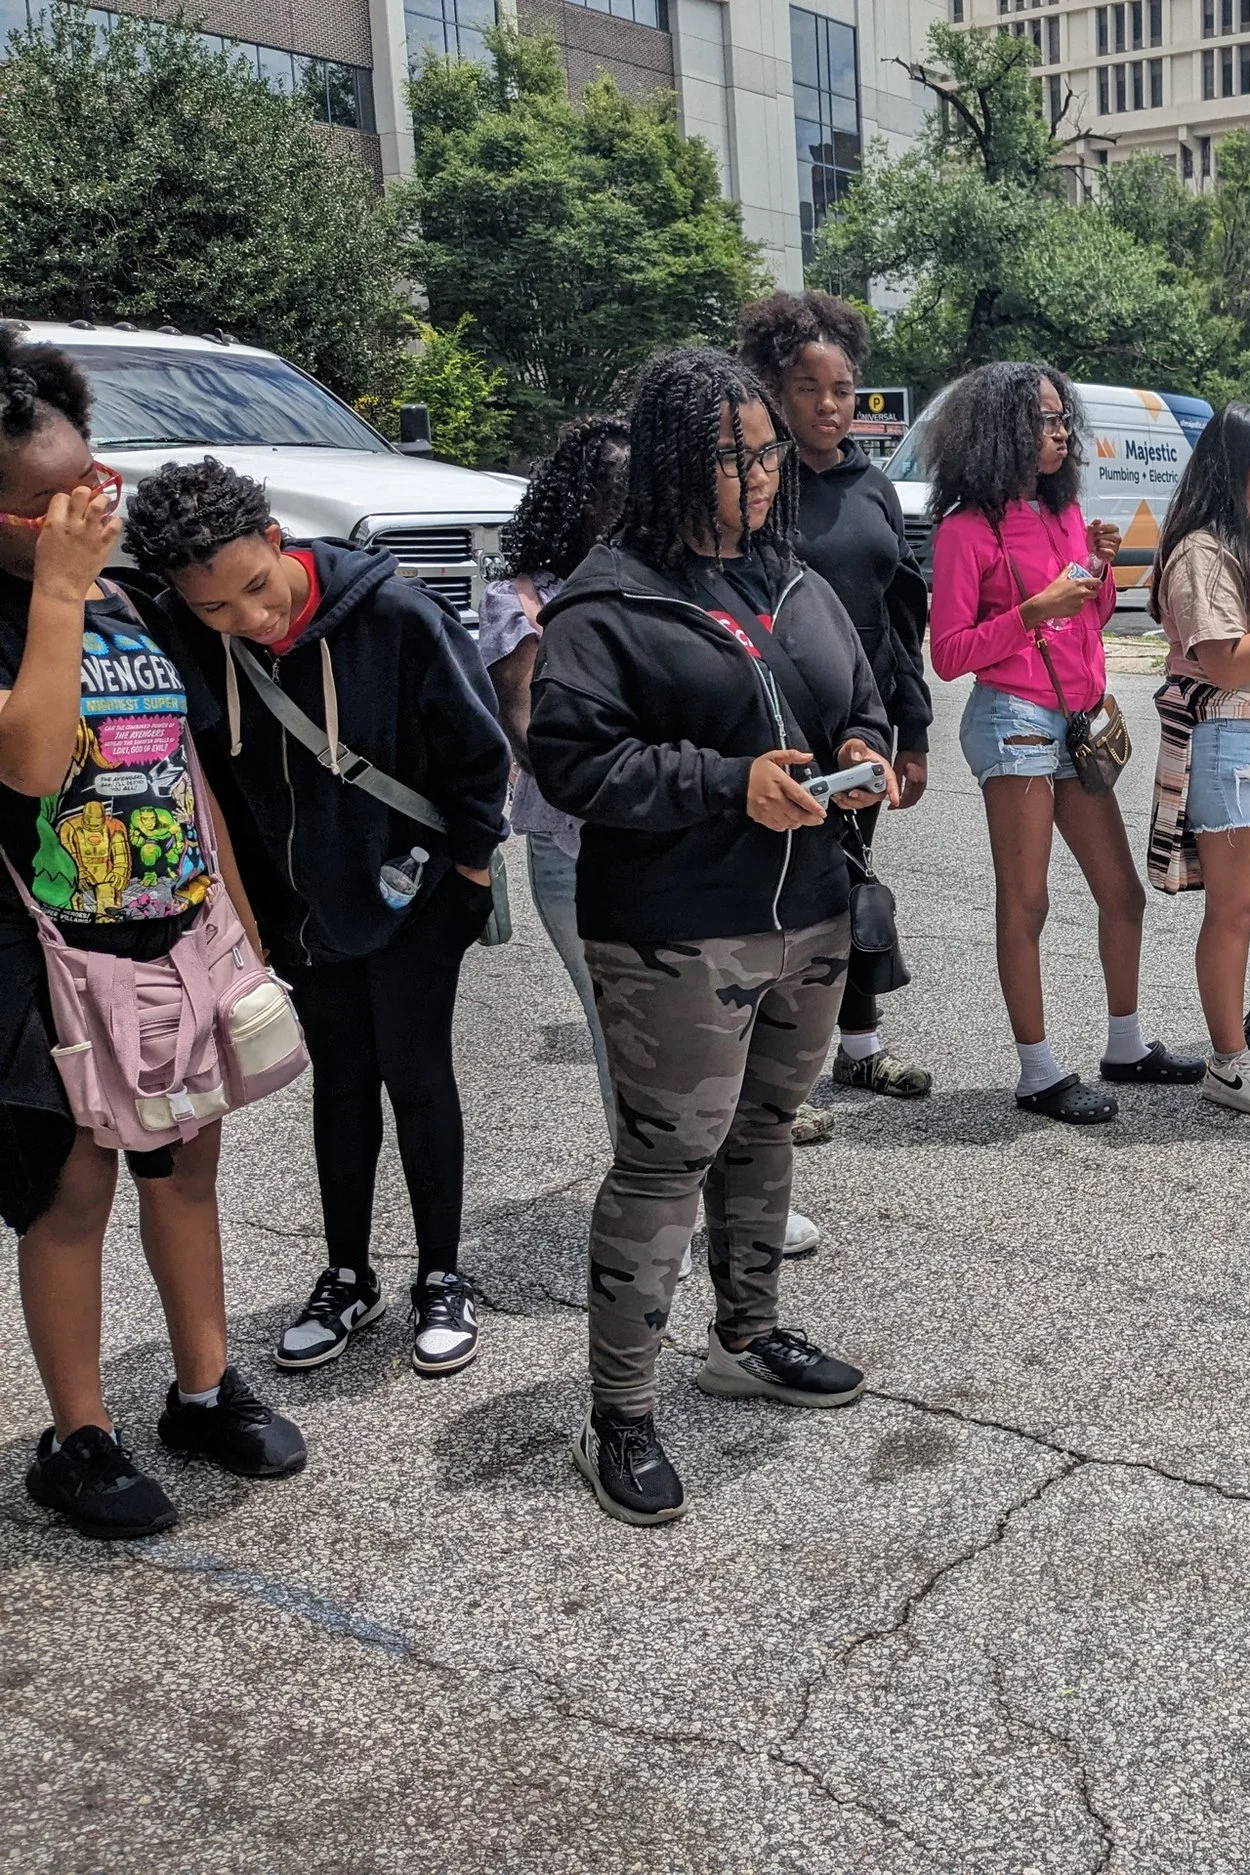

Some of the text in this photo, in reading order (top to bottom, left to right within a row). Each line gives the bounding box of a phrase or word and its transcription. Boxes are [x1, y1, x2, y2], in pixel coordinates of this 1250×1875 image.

[856, 412, 898, 421] UNIVERSAL
[1125, 439, 1178, 466] Majestic
[1099, 466, 1178, 484] Plumbing Electric
[81, 655, 185, 692] AVENGER
[143, 697, 178, 710] SUPER
[115, 729, 166, 739] THE AVENGERS
[131, 745, 143, 754] GOD
[143, 744, 151, 752] OF
